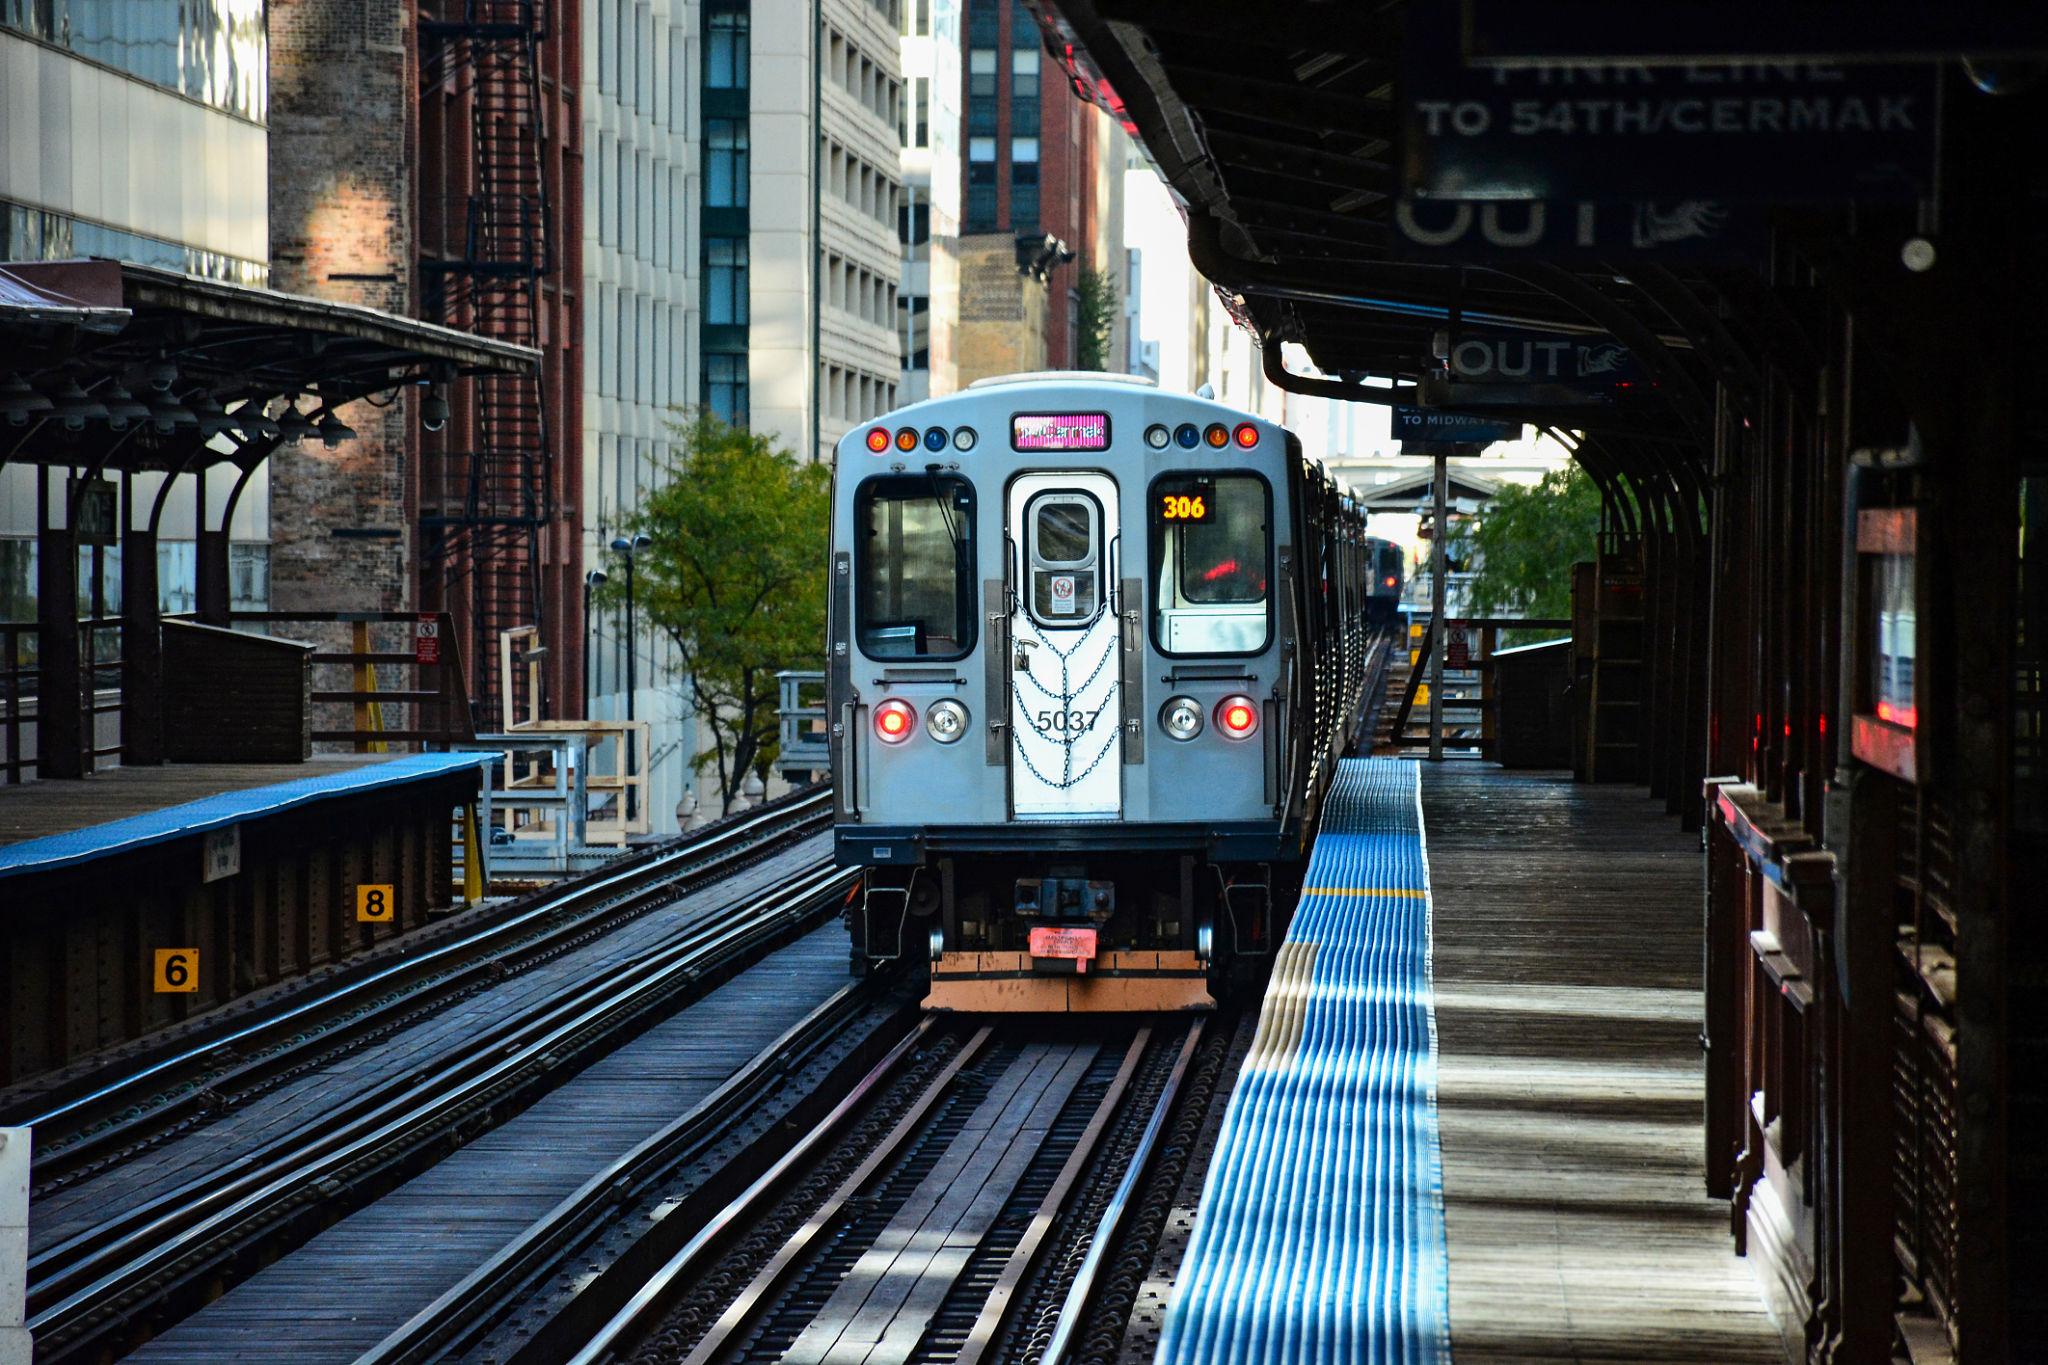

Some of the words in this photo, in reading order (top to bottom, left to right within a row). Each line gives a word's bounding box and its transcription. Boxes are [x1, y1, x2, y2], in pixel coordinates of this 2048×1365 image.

[1416, 101, 1491, 137] TO
[1509, 96, 1916, 136] 54TH/CERMAK
[1452, 340, 1571, 377] OUT
[1402, 415, 1422, 426] TO
[1163, 496, 1205, 519] 306
[1037, 710, 1099, 731] 5037
[365, 889, 385, 917] 8
[164, 954, 189, 986] 6
